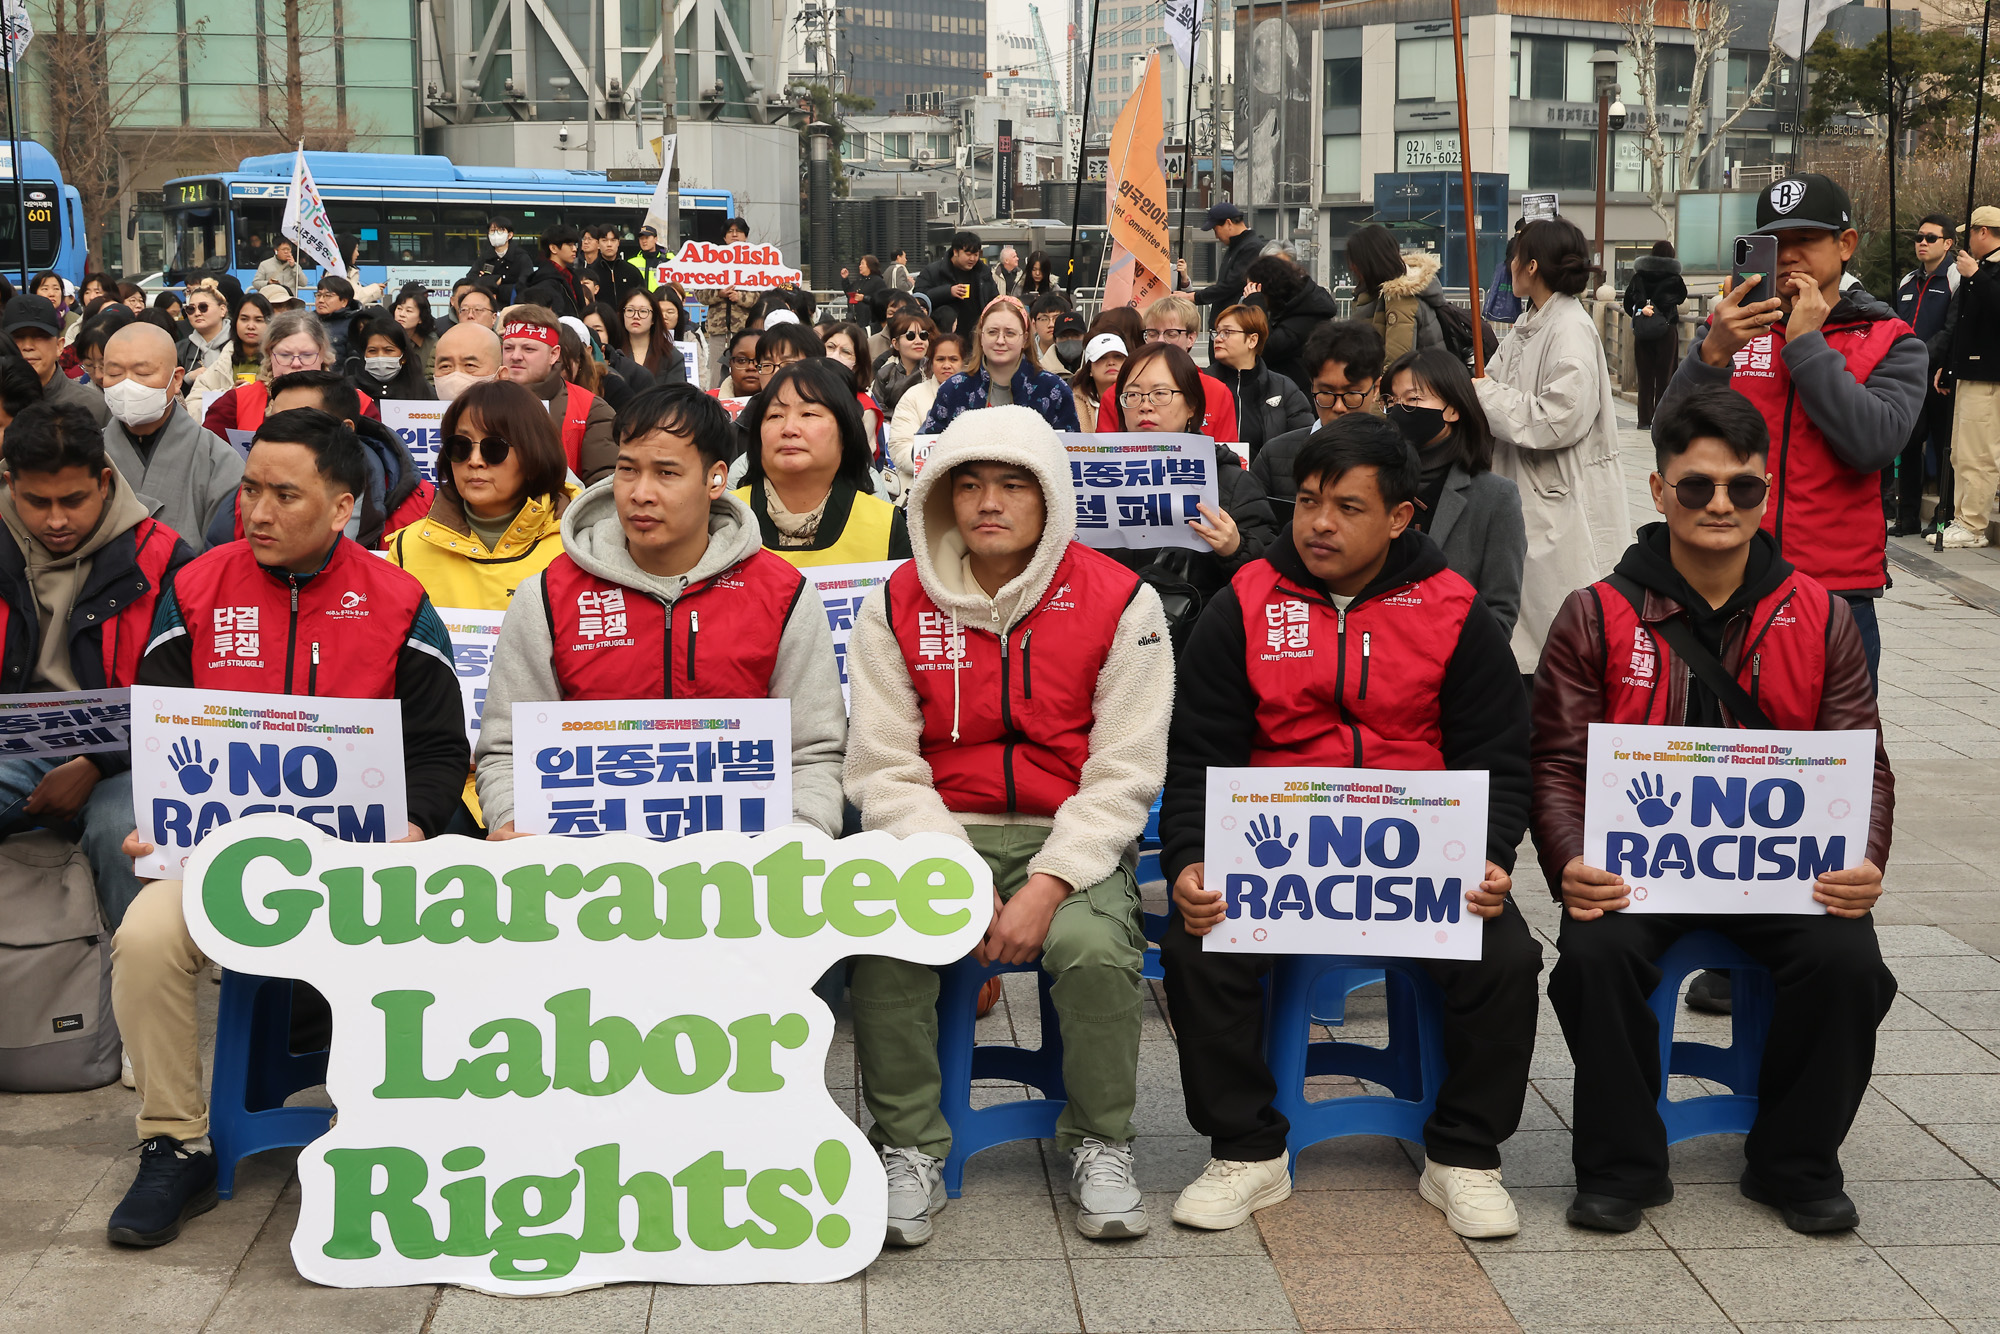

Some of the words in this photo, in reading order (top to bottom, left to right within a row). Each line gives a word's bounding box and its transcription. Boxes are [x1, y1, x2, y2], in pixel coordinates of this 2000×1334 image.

[1406, 140, 1425, 152] 02)
[1406, 152, 1462, 165] 2176-6023
[180, 184, 204, 203] 721
[619, 197, 638, 205] 전기버스
[1780, 184, 1792, 208] B
[28, 210, 52, 222] 601
[1124, 214, 1161, 249] Committee
[680, 242, 780, 266] Abolish
[658, 267, 730, 286] Forced
[734, 270, 801, 288] Labor!
[1742, 371, 1775, 379] STRUGGLE!
[408, 412, 441, 420] 2026년
[1064, 446, 1096, 454] 026년
[576, 587, 626, 615] 단결
[214, 606, 260, 633] 단결
[1265, 600, 1310, 627] 단결
[578, 612, 628, 641] 투쟁
[214, 632, 260, 658] 투쟁
[572, 642, 594, 652] UNITE!
[596, 638, 635, 649] STRUGGLE!
[919, 636, 966, 661] 투쟁
[1138, 636, 1162, 647] ellesse
[1266, 624, 1310, 652] 투쟁
[208, 660, 226, 669] UNITE!
[226, 659, 265, 669] STRUGGLE!
[936, 660, 973, 671] STRUGLE!
[1260, 654, 1281, 662] UNITE
[1281, 650, 1314, 659] STRUGGLE!
[155, 714, 170, 725] for
[172, 715, 190, 726] the
[191, 717, 248, 729] Elimination
[250, 721, 261, 730] of
[263, 721, 295, 732] Racial
[297, 723, 374, 735] Discrimination
[204, 705, 228, 716] 2026
[229, 707, 297, 721] International
[299, 711, 319, 723] Day
[562, 720, 617, 732] 2026년
[618, 718, 741, 731] 세계인종차별철폐의날
[1614, 751, 1631, 761] for
[1633, 751, 1652, 761] the
[1653, 752, 1716, 763] Elimination
[1717, 754, 1730, 764] of
[1732, 755, 1766, 766] Racial
[1768, 756, 1847, 766] Discrimination
[1667, 741, 1694, 751] 2026
[1695, 742, 1769, 754] International
[1771, 745, 1793, 756] Day
[229, 742, 338, 798] NO
[536, 739, 776, 790] 인종차별
[1284, 782, 1310, 792] 2026
[1311, 782, 1384, 793] International
[1385, 784, 1406, 796] Day
[1232, 793, 1249, 803] for
[1251, 793, 1269, 803] the
[1271, 794, 1332, 803] Elimination
[1333, 794, 1345, 804] of
[1347, 794, 1381, 805] Racial
[1382, 796, 1461, 807] Discrimination
[1691, 776, 1805, 829] NO
[153, 798, 386, 848] RASM
[1308, 815, 1420, 869] NO
[1606, 831, 1846, 881] RACISM
[201, 836, 974, 948] Guarantee
[1226, 874, 1462, 924] RACISM
[372, 986, 810, 1099] Labor
[322, 1138, 852, 1282] Rights!
